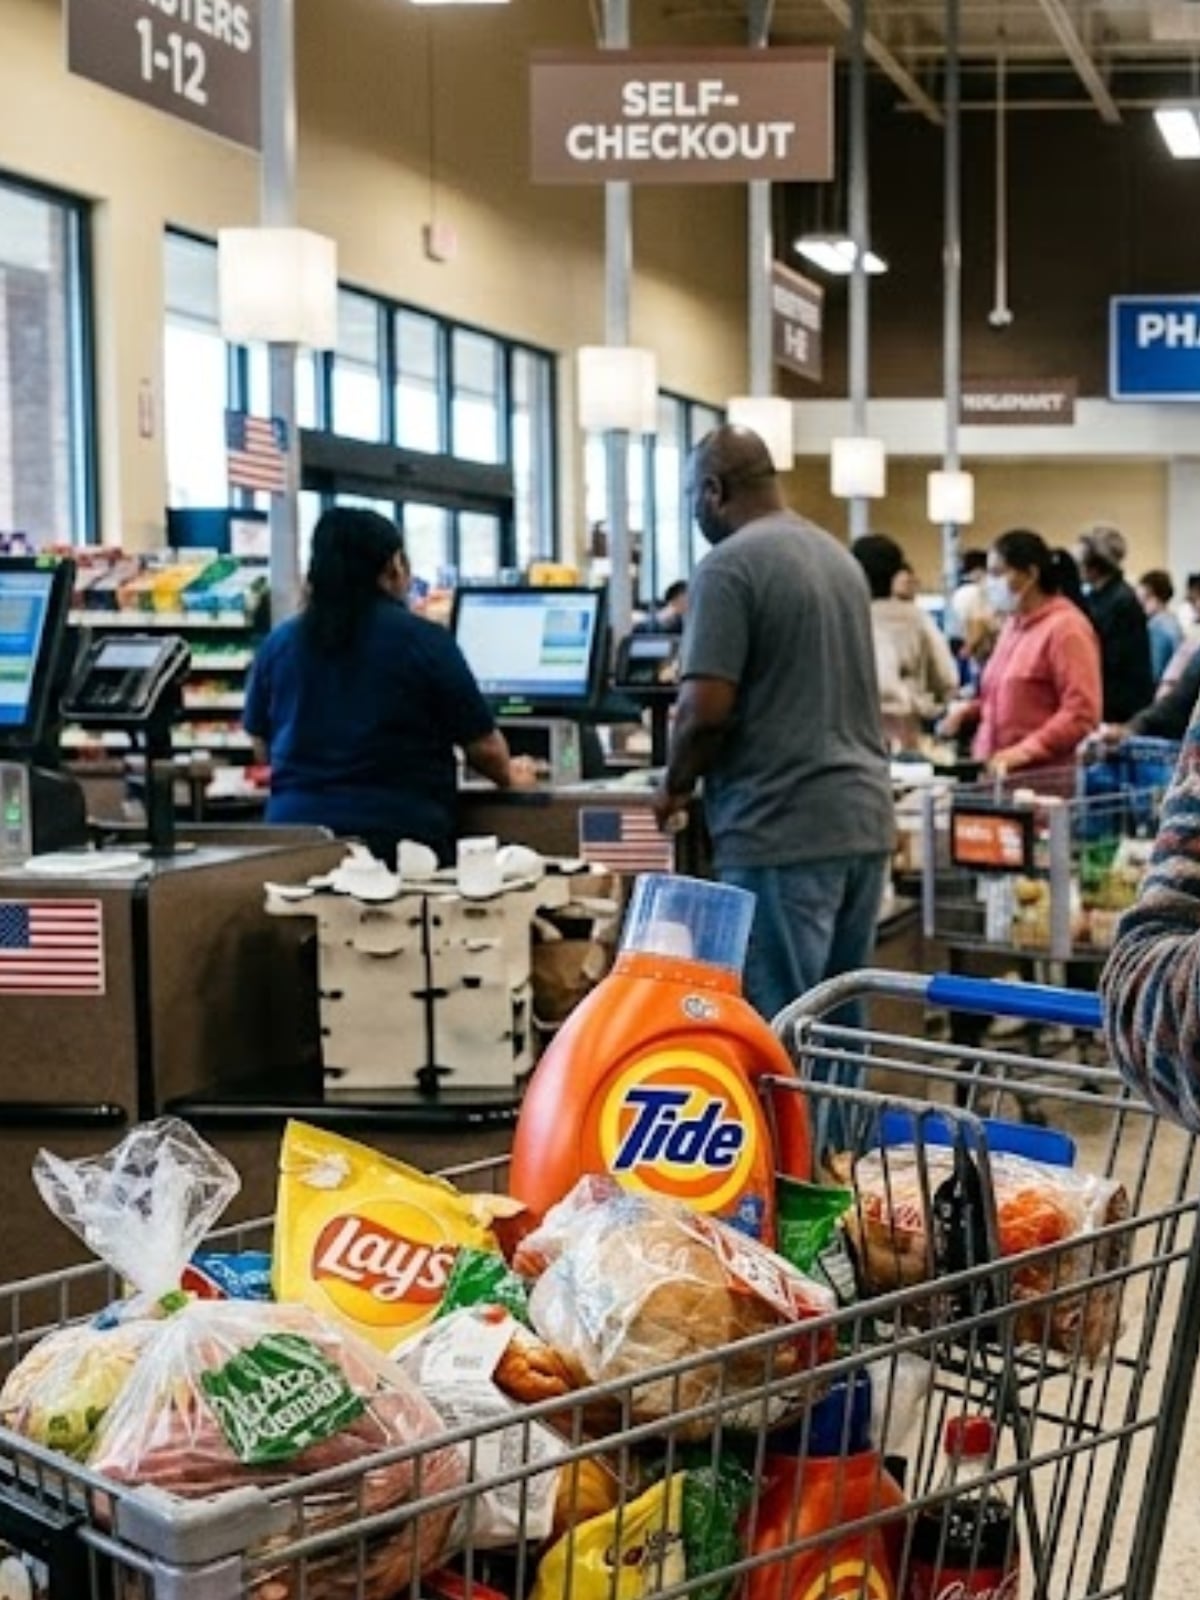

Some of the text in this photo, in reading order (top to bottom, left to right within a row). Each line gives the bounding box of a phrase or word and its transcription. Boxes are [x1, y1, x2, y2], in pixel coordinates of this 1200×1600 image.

[136, 18, 207, 106] 1-12
[622, 79, 740, 117] SELF-
[565, 121, 796, 160] CHECKOUT
[613, 1088, 745, 1171] Tide
[317, 1217, 455, 1302] Lay's
